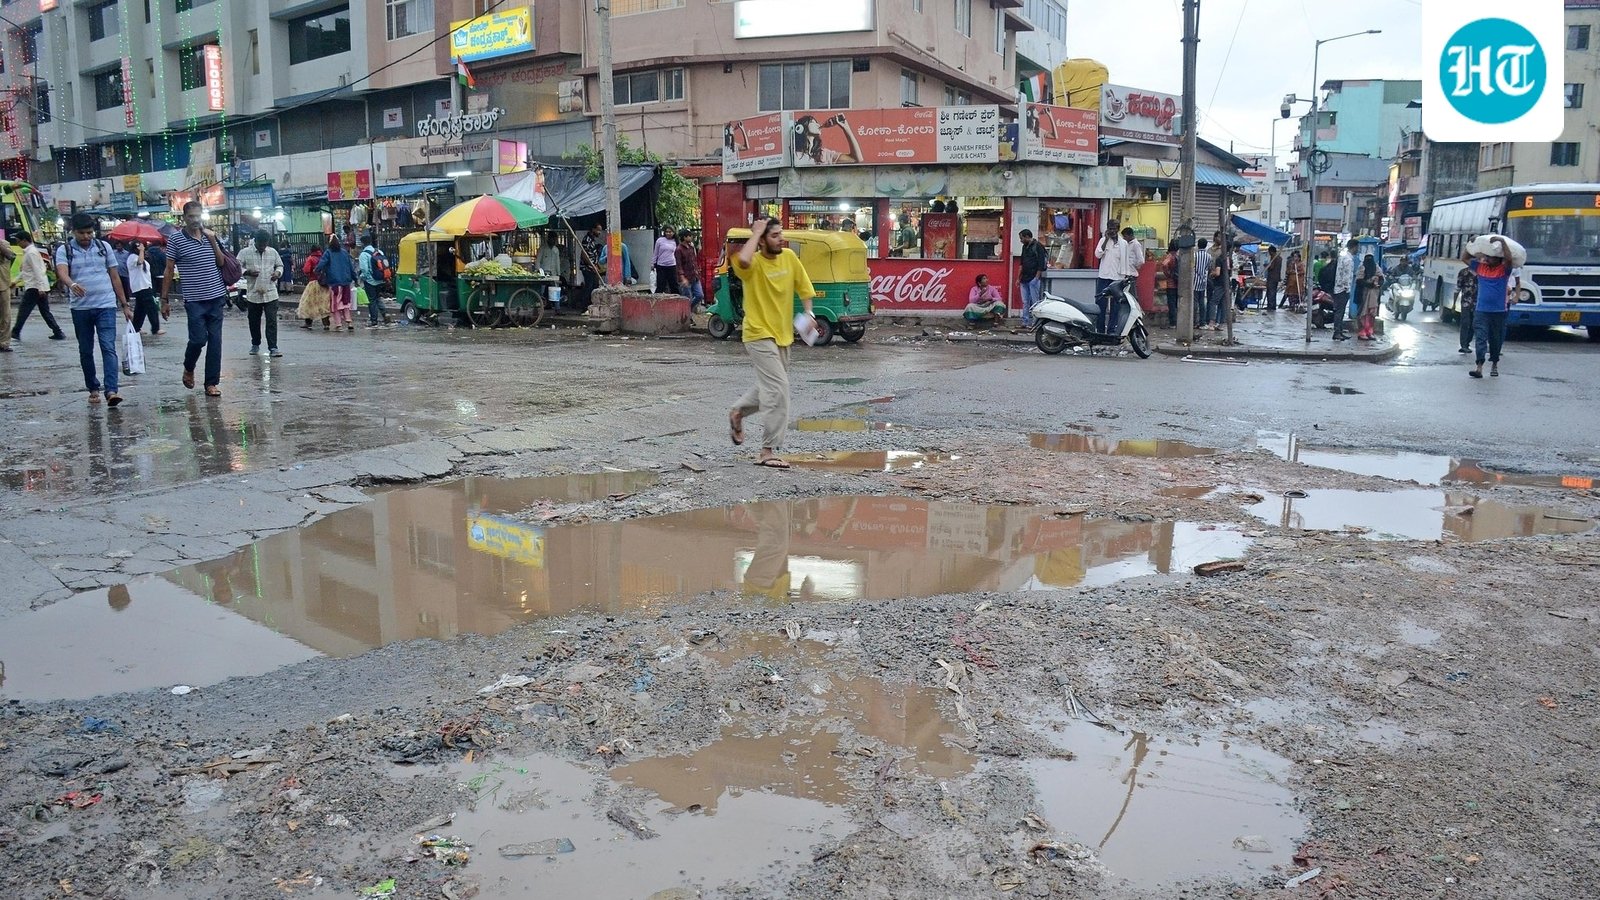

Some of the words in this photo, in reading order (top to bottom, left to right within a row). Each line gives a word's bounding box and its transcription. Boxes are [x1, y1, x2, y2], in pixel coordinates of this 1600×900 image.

[209, 59, 221, 108] LODGE
[939, 110, 950, 124] ಶ್ರೀ
[417, 108, 499, 141] ಚಂದ್ರಪ್ರಕಾಶ್
[857, 123, 935, 136] ಕೋಕಾ-ಕೋಲಾ
[966, 127, 973, 136] &
[1525, 195, 1534, 209] 6
